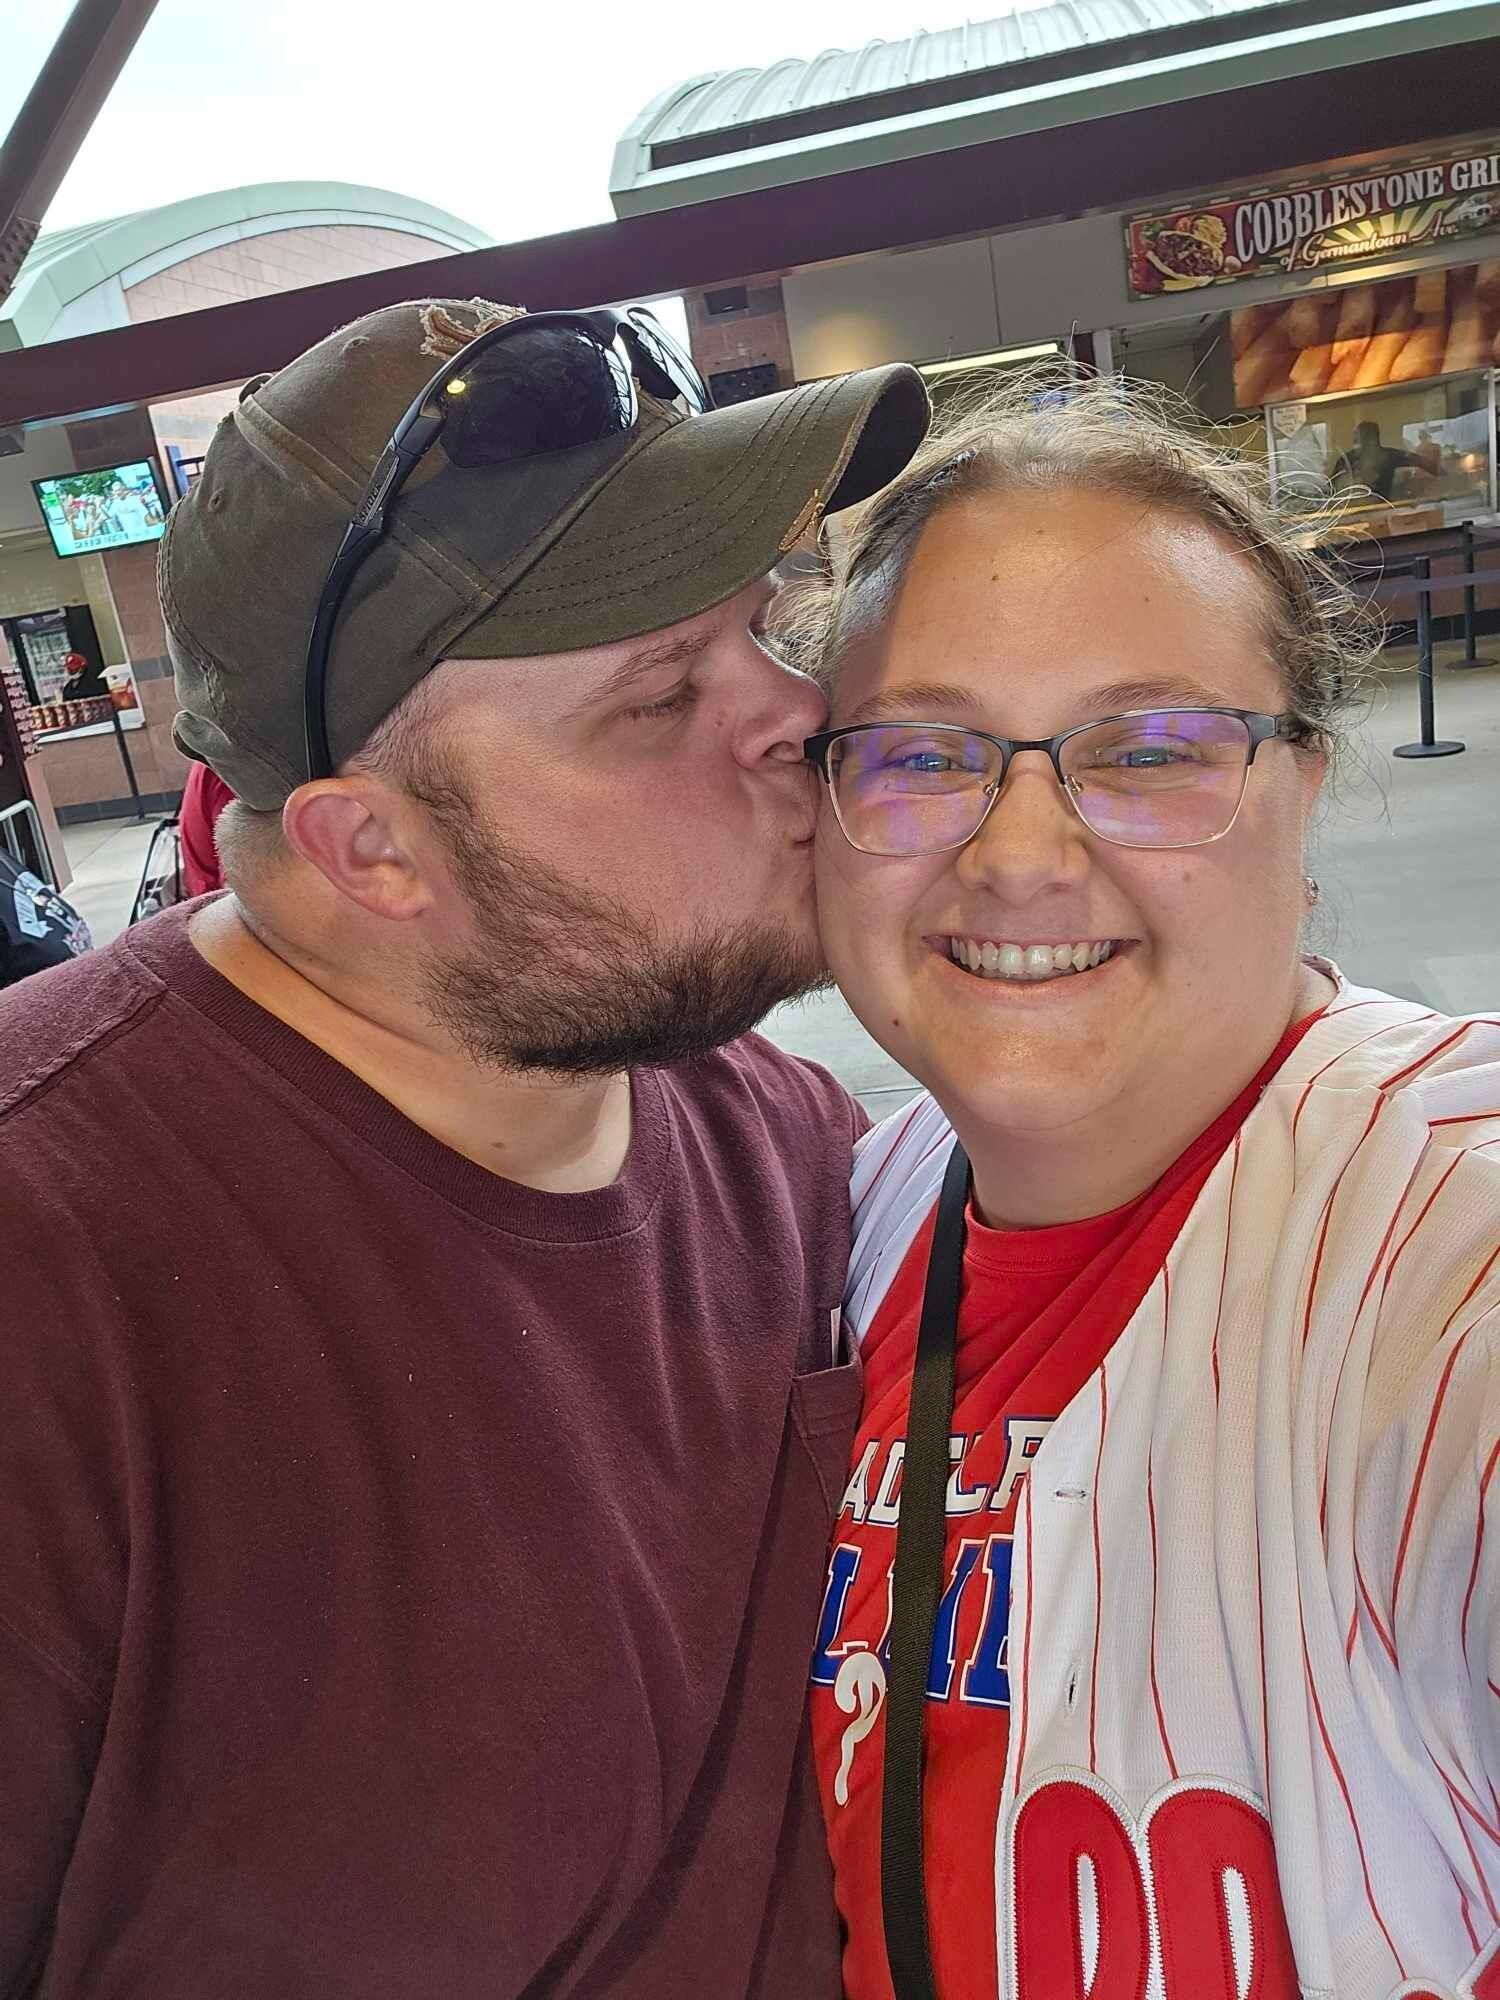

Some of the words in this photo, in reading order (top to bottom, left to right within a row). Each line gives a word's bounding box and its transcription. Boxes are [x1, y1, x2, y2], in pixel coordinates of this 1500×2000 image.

[1234, 166, 1445, 262] COBBLESTONE
[1280, 236, 1300, 272] of
[1302, 232, 1408, 269] Germantown
